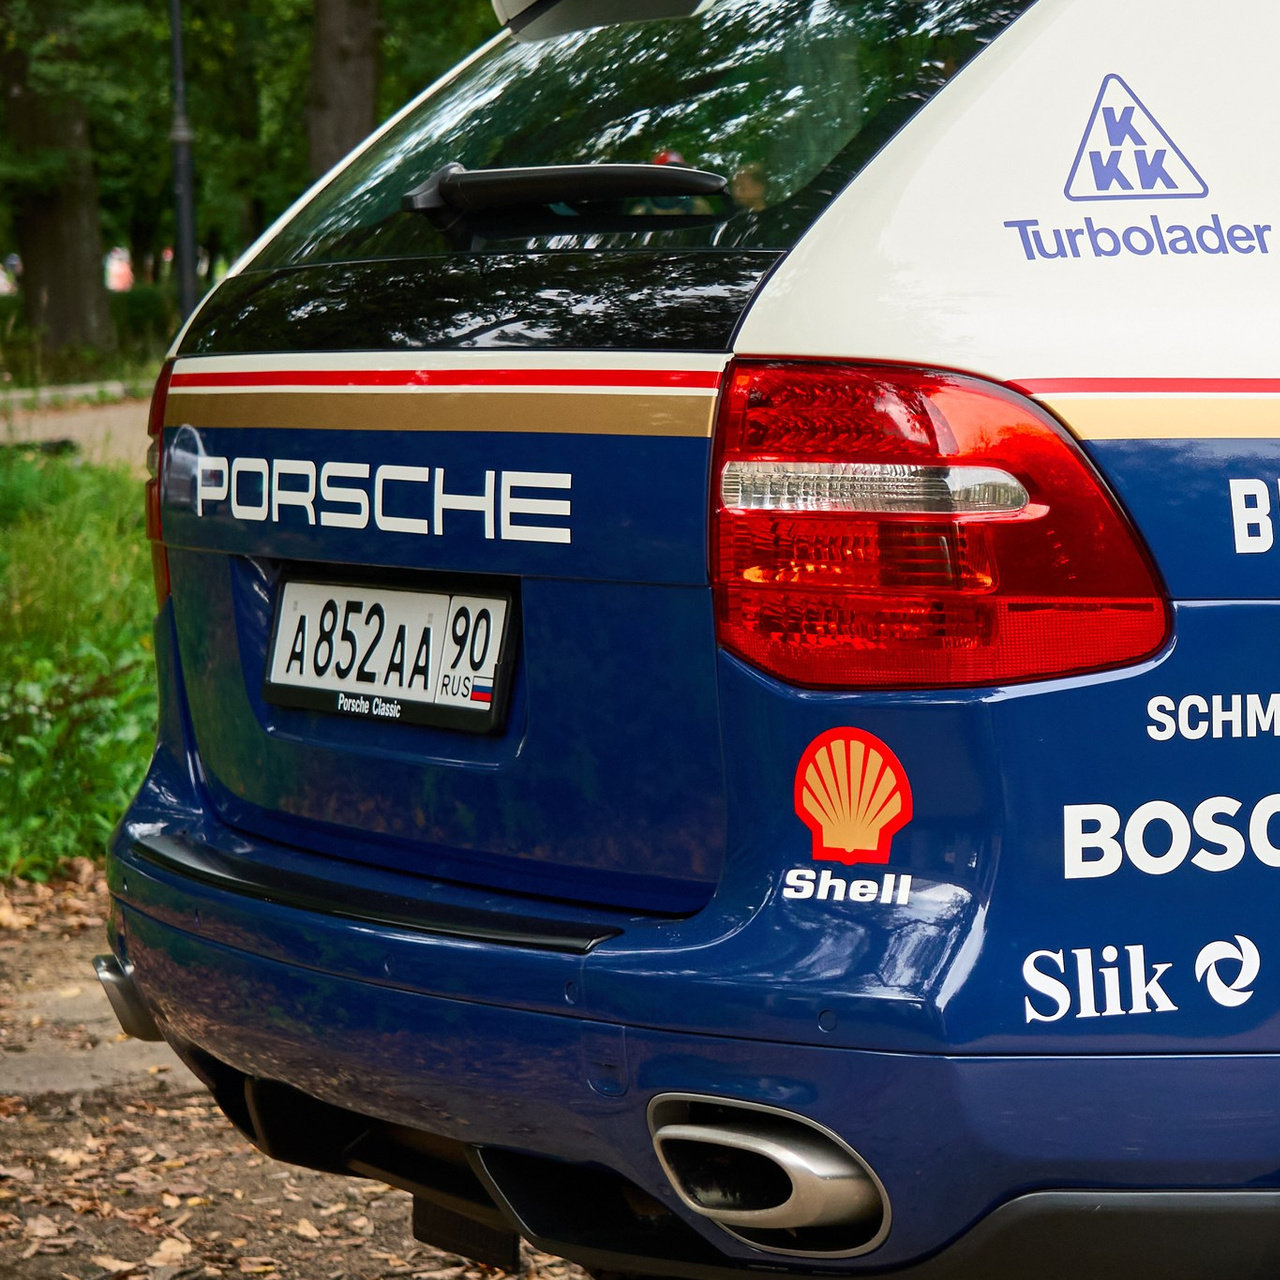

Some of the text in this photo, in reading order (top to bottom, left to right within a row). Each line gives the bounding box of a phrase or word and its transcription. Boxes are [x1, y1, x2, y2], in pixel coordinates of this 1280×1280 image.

[1003, 214, 1272, 261] Turbolader
[196, 456, 572, 544] PORSCHE
[285, 598, 493, 691] A852AA 90
[337, 692, 402, 719] Porsche Classic
[440, 674, 471, 698] RUS
[782, 869, 912, 906] Shell
[1022, 944, 1178, 1024] Slik
